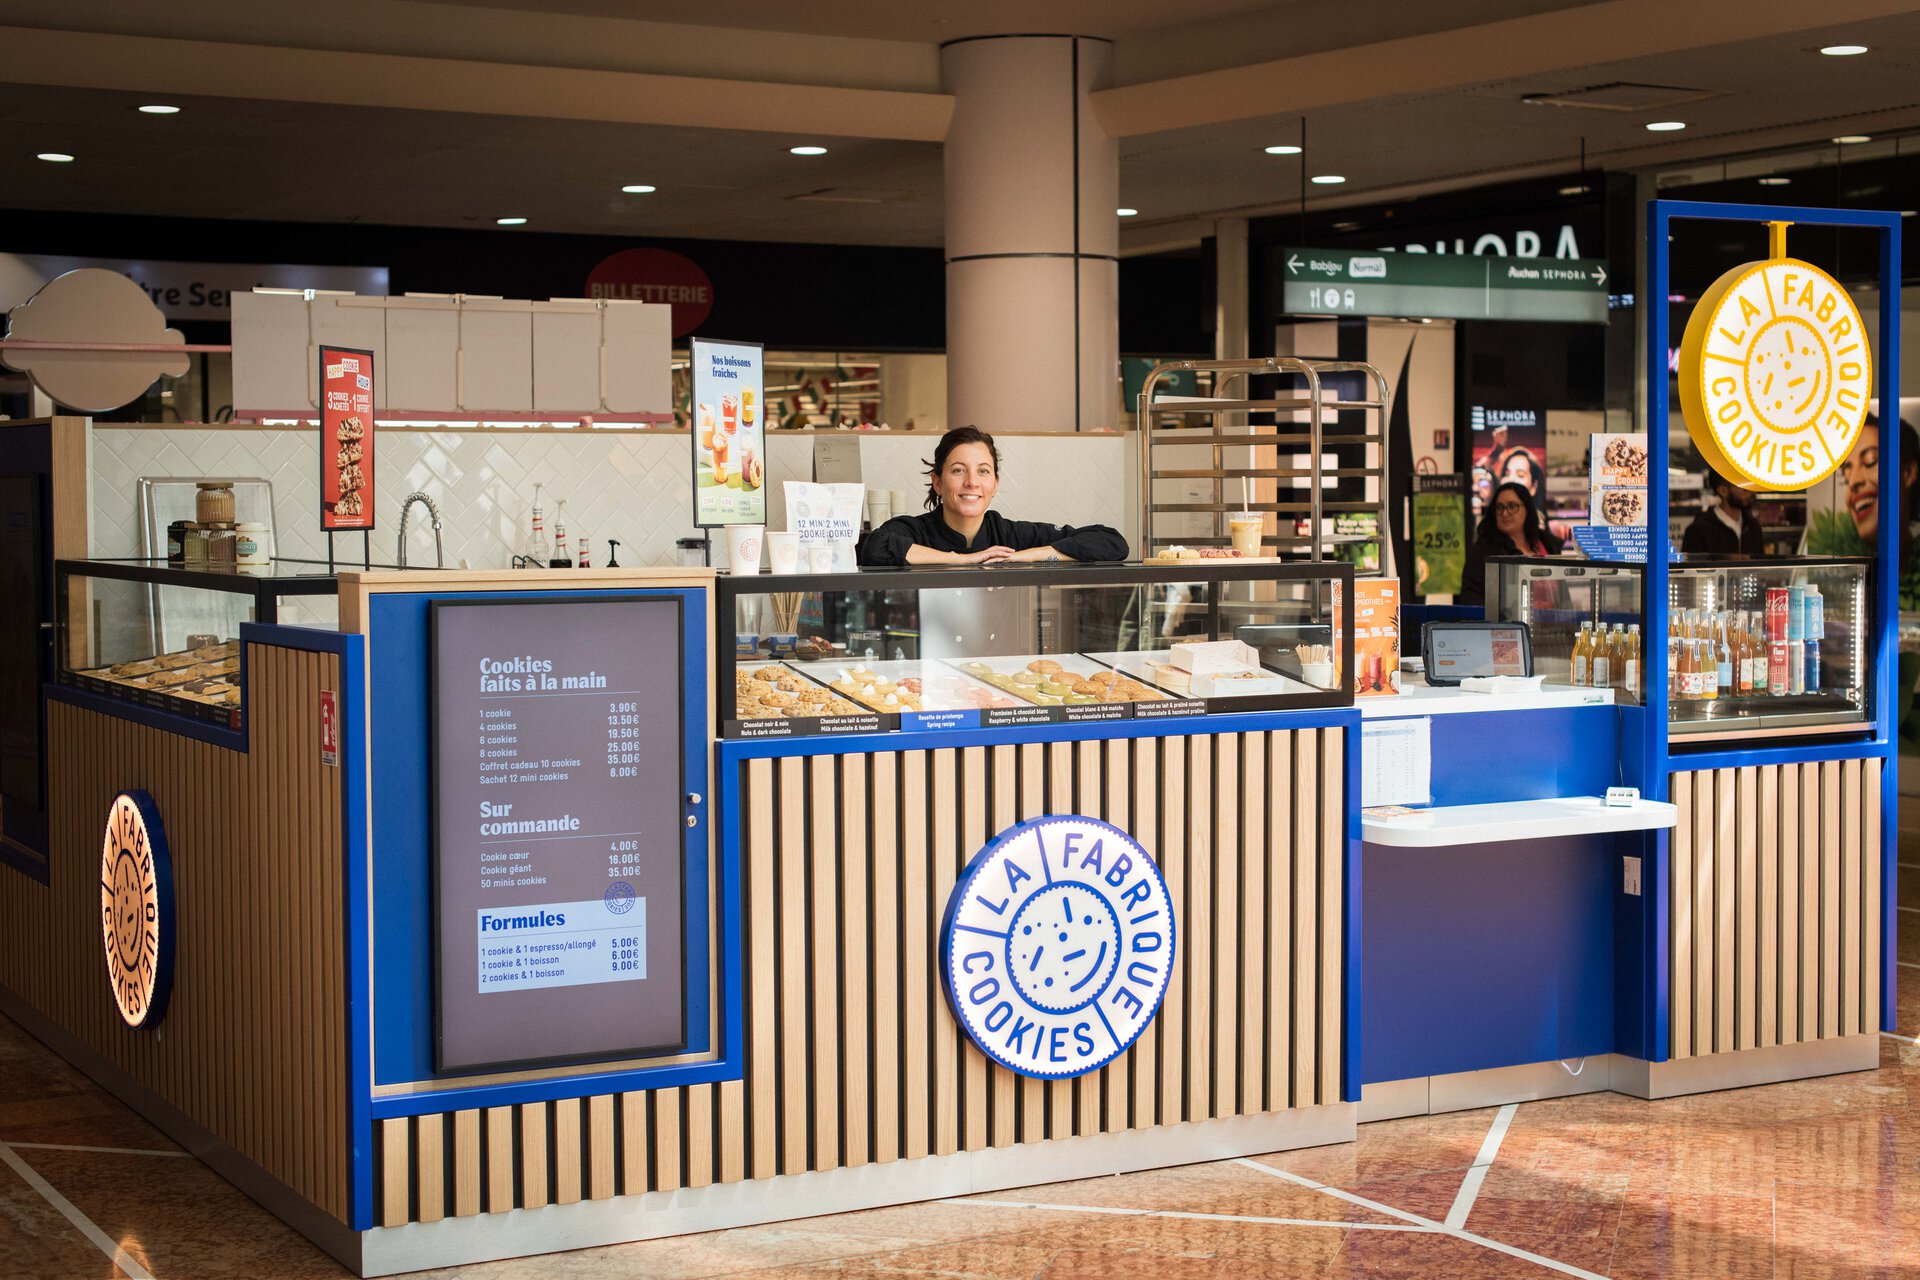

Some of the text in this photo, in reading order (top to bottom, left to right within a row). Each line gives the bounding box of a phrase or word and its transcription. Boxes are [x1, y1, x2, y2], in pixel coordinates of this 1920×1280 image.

[1354, 262, 1383, 273] Normal
[1508, 266, 1586, 281] Auchan SEPHORA
[592, 283, 708, 303] BILLETTERIE
[712, 355, 752, 367] Nos boissons
[1712, 274, 1862, 476] LA FABRIQUE COOKIES
[328, 392, 333, 409] 3
[1486, 410, 1536, 422] SEPHORA
[1605, 468, 1628, 476] HAPPY
[1422, 479, 1459, 487] SEPHORA
[1617, 477, 1647, 485] COOKIES
[798, 520, 806, 528] 12
[833, 520, 850, 528] MINI
[799, 530, 825, 538] COOKIE
[480, 656, 552, 674] Cookies
[480, 671, 607, 692] faits à la main
[610, 702, 637, 713] 3.90€
[1066, 706, 1085, 714] Chocolat
[1109, 704, 1124, 712] matcha
[1137, 702, 1156, 710] Chocolat
[1188, 700, 1205, 708] noisette
[486, 709, 512, 718] cookie
[942, 713, 964, 721] printemps
[990, 707, 1049, 717] Framboise chocolat blanc
[1081, 712, 1102, 720] chocolate
[1106, 711, 1122, 719] matcha
[1147, 709, 1167, 717] chocolate
[1171, 708, 1190, 716] hazelnut
[608, 714, 639, 725] 13.50€
[743, 720, 762, 728] Chocolat
[763, 720, 773, 728] noir
[820, 717, 840, 726] Chocolat
[847, 716, 855, 724] lait
[860, 716, 879, 724] noisette
[926, 720, 956, 729] Spring recipe
[989, 715, 1050, 726] Raspberry white chocolate
[480, 722, 517, 731] 4 cookies
[769, 727, 792, 735] chocolate
[832, 724, 853, 732] chocolate
[859, 723, 878, 731] hazelnut
[608, 728, 639, 739] 19.50€
[480, 735, 517, 744] 6 cookies
[607, 741, 640, 752] 25.00€
[480, 749, 517, 758] 8 cookies
[607, 753, 640, 764] 35.00€
[480, 758, 581, 771] Coffret cadeau 10 cookies
[610, 767, 638, 777] 8.00€
[480, 772, 569, 784] Sachet 12 mini cookies
[480, 801, 513, 818] Sur
[480, 814, 581, 836] commande
[611, 840, 638, 851] 4.00€
[480, 853, 507, 862] Cookie
[608, 853, 640, 864] 16.00€
[480, 863, 532, 875] Cookie géant
[608, 866, 641, 877] 35.00€
[481, 876, 547, 888] 50 minis cookies
[104, 805, 156, 1016] LA FABRIQUE COOKIES
[481, 911, 566, 932] Formules
[488, 946, 513, 956] cookie
[515, 945, 522, 954] &
[530, 939, 597, 954] espresso/allongé
[612, 937, 639, 948] 5.00€
[963, 833, 1162, 1062] LA FABRIQUE COOKIES
[612, 949, 639, 960] 6.00€
[488, 959, 513, 969] cookie
[515, 958, 522, 967] &
[530, 956, 560, 966] boisson
[612, 960, 639, 972] 9.00€
[482, 974, 487, 983] 2
[489, 973, 519, 982] cookies
[521, 971, 527, 979] &
[535, 968, 565, 978] boisson
